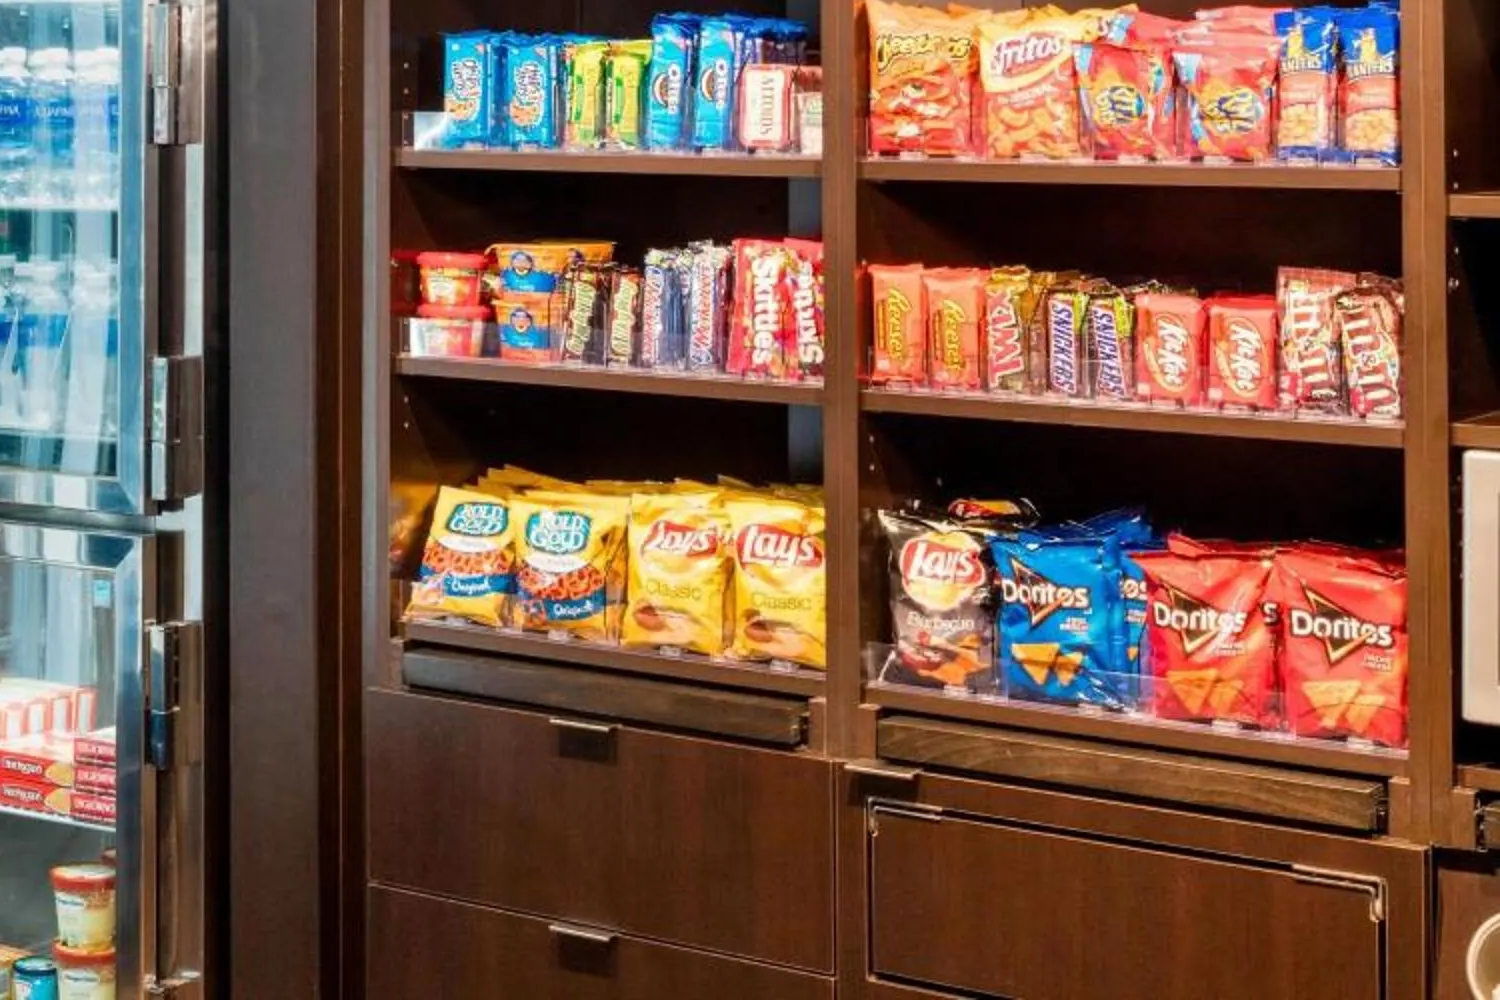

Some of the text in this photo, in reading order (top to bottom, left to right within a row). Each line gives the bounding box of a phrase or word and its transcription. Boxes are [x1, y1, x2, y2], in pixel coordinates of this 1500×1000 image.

[989, 34, 1064, 74] Fritos
[751, 256, 780, 364] Skittles
[987, 289, 1025, 387] TWIX
[1052, 303, 1076, 392] SNICKERS
[1095, 310, 1126, 396] SNICKERS
[450, 516, 503, 535] GOLD
[462, 502, 505, 520] ROLD
[530, 528, 586, 550] GOLD
[644, 521, 717, 556] Lay's
[741, 525, 816, 567] Lay's
[908, 540, 975, 582] Lay's
[646, 579, 701, 601] Classic
[752, 593, 813, 611] Classic
[1002, 578, 1091, 609] Doritos
[1153, 601, 1248, 633] Doritos
[1290, 608, 1394, 647] Doritos
